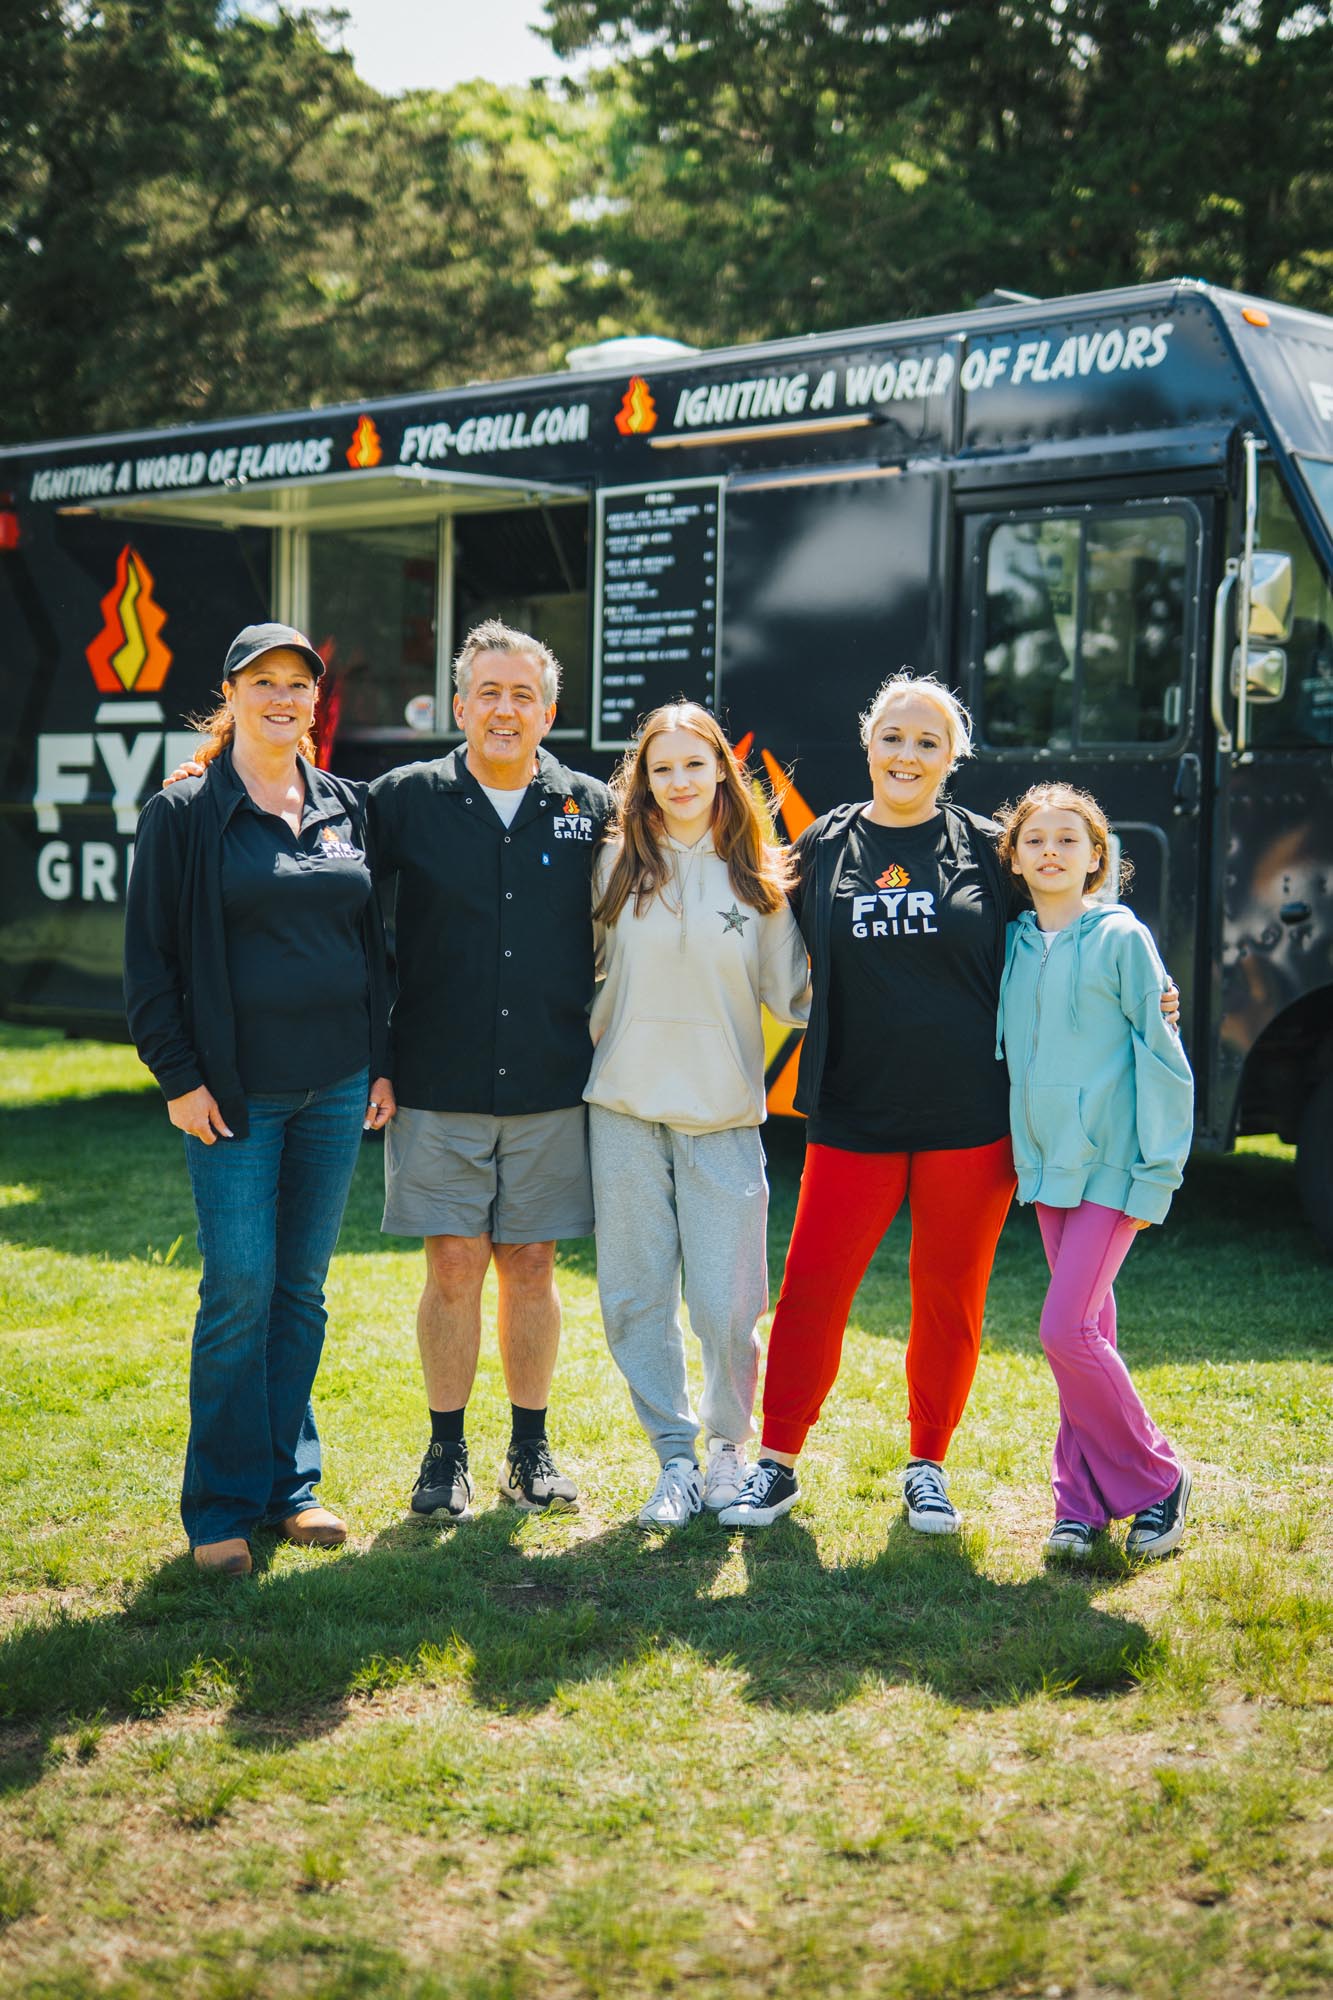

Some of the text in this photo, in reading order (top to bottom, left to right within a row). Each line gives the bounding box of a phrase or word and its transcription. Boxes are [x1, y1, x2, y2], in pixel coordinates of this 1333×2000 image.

[673, 373, 809, 428] IGNITING
[810, 370, 837, 410] A
[960, 346, 1011, 391] OF
[1010, 322, 1174, 385] FLAVORS
[400, 404, 590, 462] FYR-GRILL.COM
[30, 438, 334, 501] IGNITING A WORLD OF FLAVORS
[553, 816, 592, 832] FYR
[554, 831, 593, 841] GRILL
[852, 891, 936, 921] FYR
[852, 918, 938, 938] GRILL
